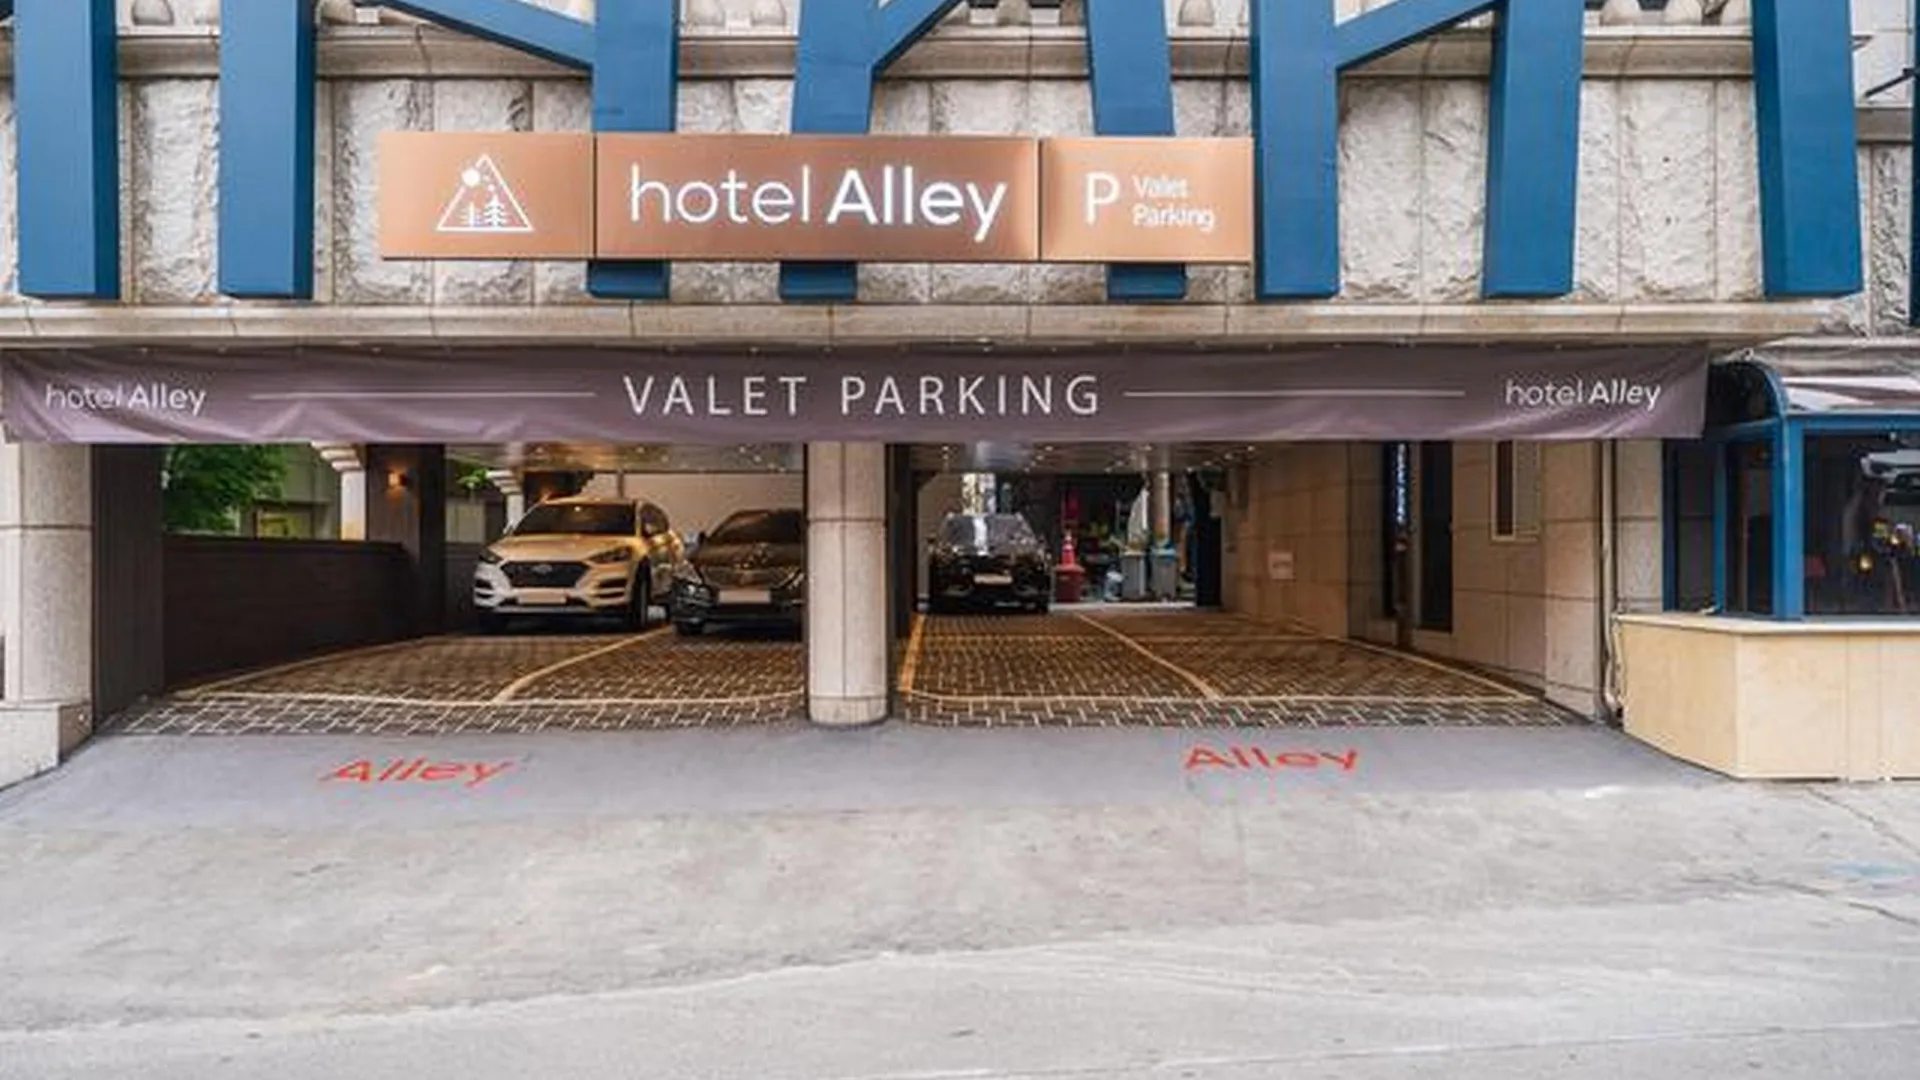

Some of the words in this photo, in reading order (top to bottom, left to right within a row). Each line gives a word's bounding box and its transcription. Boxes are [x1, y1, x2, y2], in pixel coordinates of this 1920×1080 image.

[629, 163, 811, 224] hotel
[826, 164, 1008, 243] Alley
[1085, 171, 1120, 226] P
[1131, 174, 1188, 199] Valet
[1132, 203, 1216, 233] Parking
[45, 383, 121, 410] hotel
[127, 382, 206, 416] Alley
[623, 375, 807, 416] VALET
[840, 375, 1099, 416] PARKING
[1505, 379, 1583, 406] hotel
[1588, 378, 1662, 411] Alley
[317, 755, 515, 788] Alley
[1185, 746, 1358, 771] Alley
